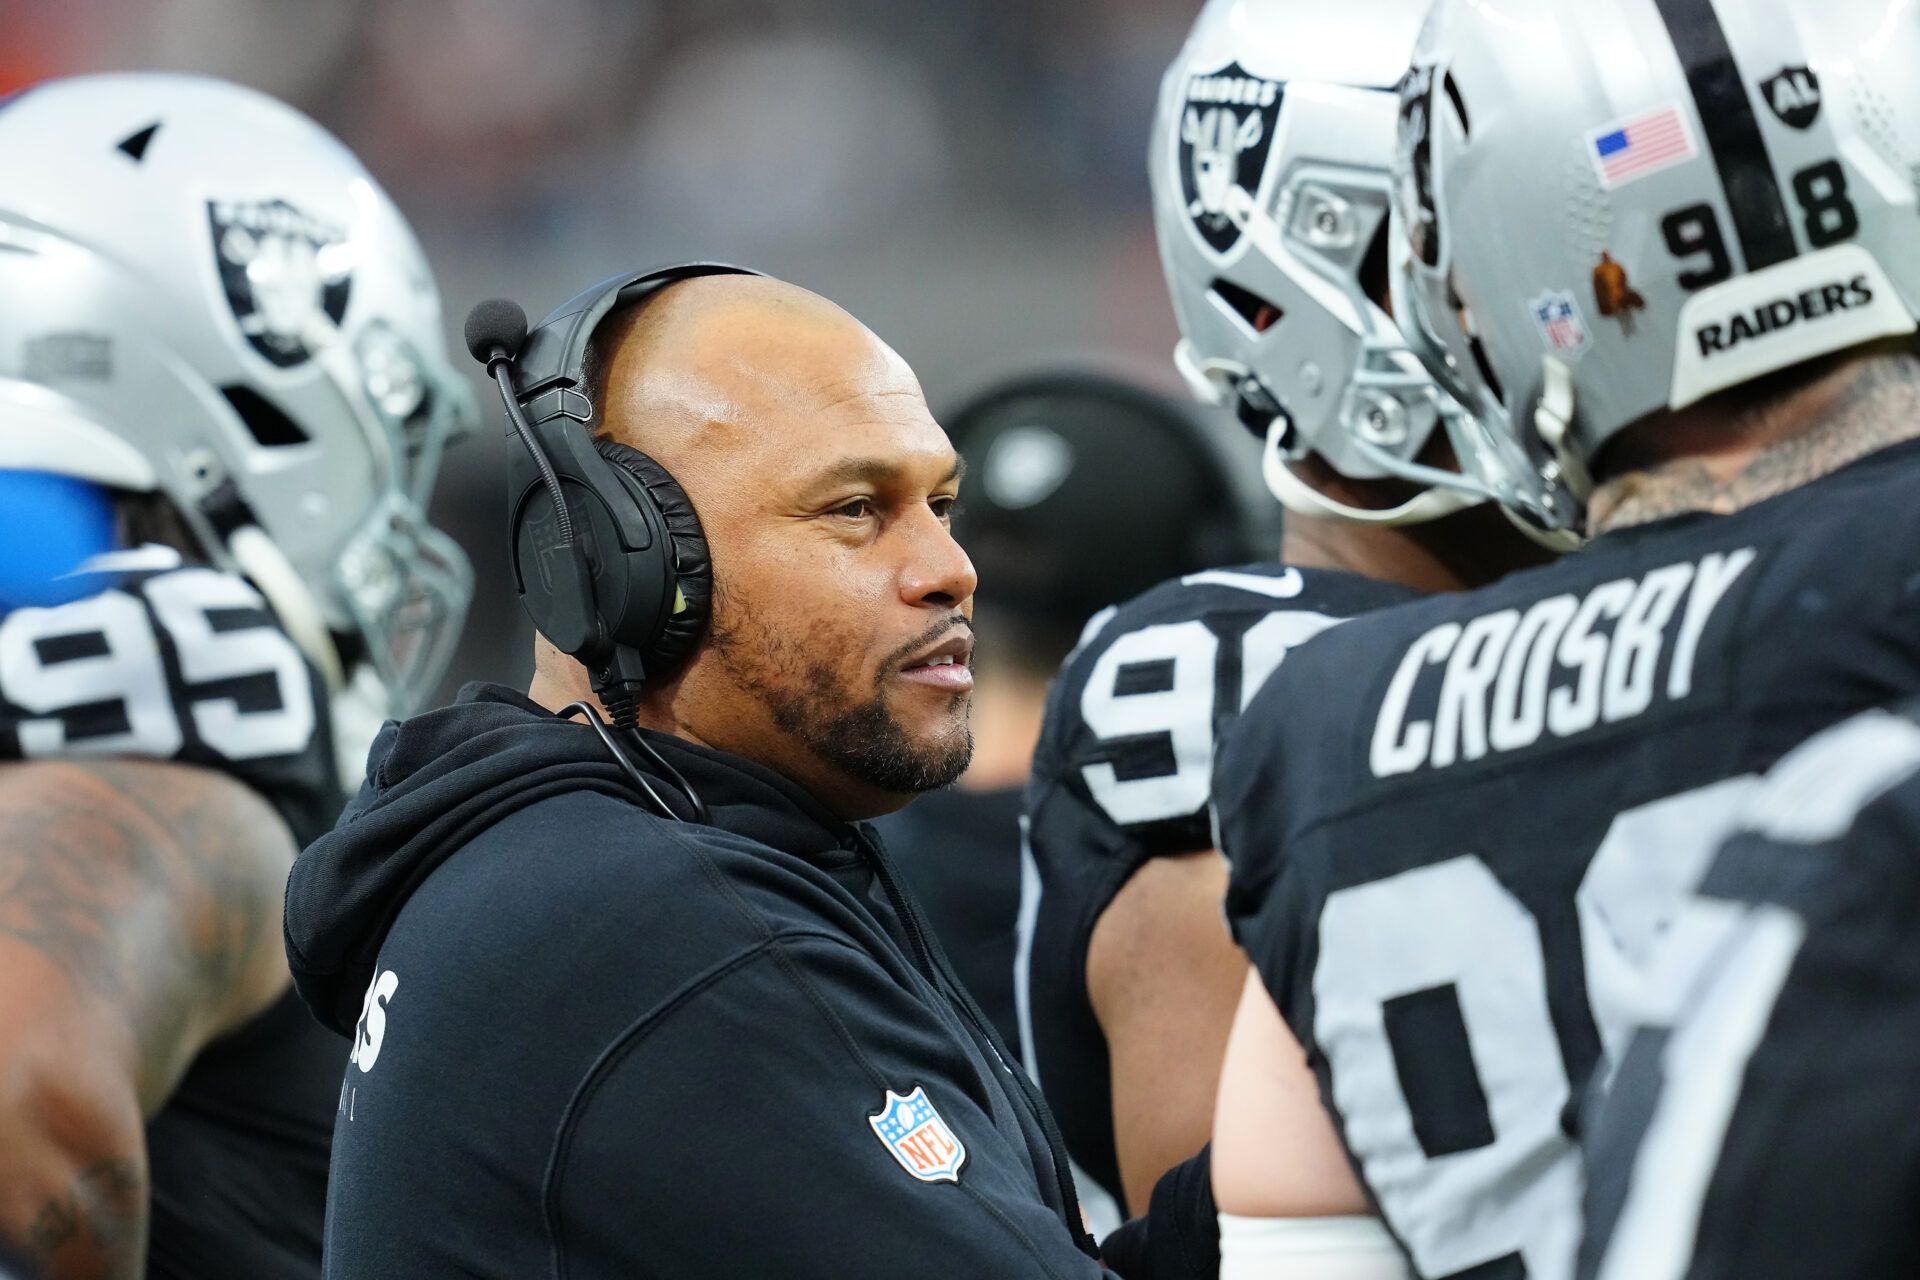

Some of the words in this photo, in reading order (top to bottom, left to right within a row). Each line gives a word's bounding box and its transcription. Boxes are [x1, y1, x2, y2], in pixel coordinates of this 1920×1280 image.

[1661, 202, 1733, 291] 9
[1792, 160, 1859, 248] 8
[1697, 274, 1873, 357] RAIDERS
[0, 567, 315, 760] 95
[1370, 546, 1757, 778] CROSBY
[899, 1123, 955, 1170] NFL
